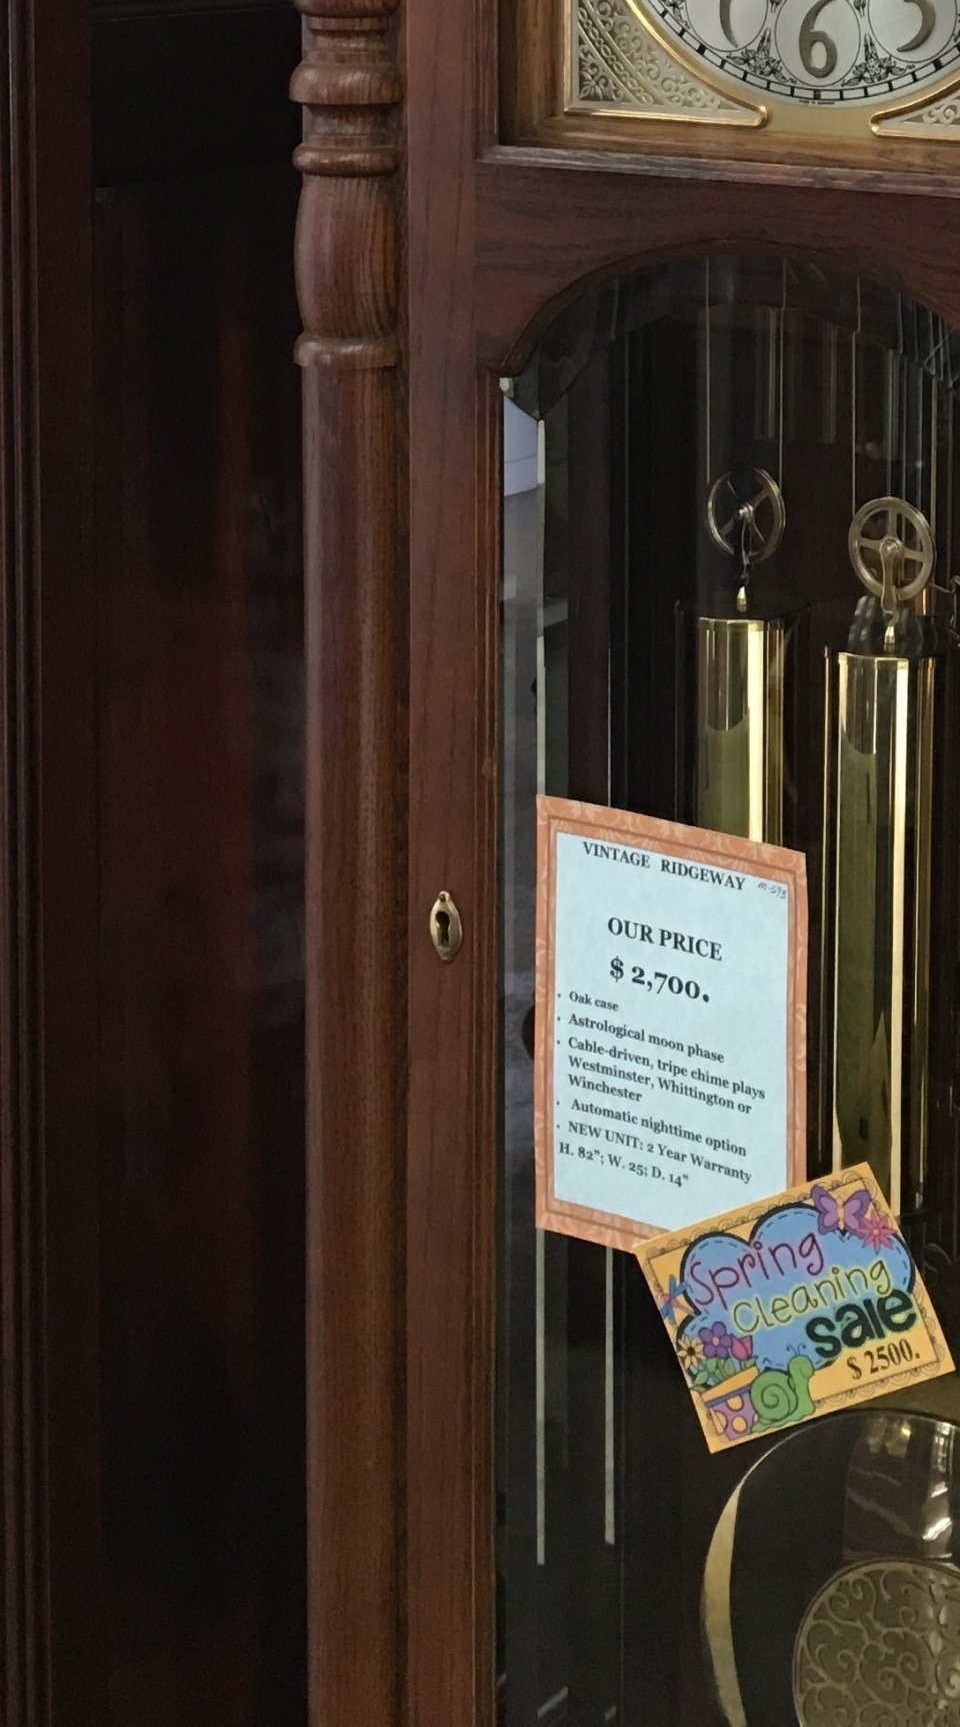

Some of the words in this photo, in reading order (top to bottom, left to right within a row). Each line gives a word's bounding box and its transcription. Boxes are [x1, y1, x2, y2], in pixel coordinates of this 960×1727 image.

[583, 841, 651, 868] VINTAGE
[661, 859, 746, 890] RIDGEWAY
[608, 917, 654, 944] OUR
[659, 929, 722, 961] PRICE
[569, 990, 592, 1005] Oak
[594, 998, 619, 1012] case
[610, 956, 624, 982] $
[632, 966, 710, 1003] 2,700.
[568, 1013, 645, 1042] Astrological
[648, 1033, 684, 1052] moon
[687, 1043, 724, 1063] phase
[568, 1036, 654, 1069] Cable-driven,
[657, 1058, 688, 1077] tripe
[691, 1067, 730, 1089] chime
[732, 1081, 766, 1099] plays
[568, 1055, 654, 1089] Westminster,
[657, 1076, 735, 1111] Whittington
[737, 1102, 752, 1115] or
[568, 1073, 643, 1102] Winchester
[571, 1098, 638, 1125] Automatic
[641, 1116, 702, 1143] nighttime
[705, 1135, 746, 1157] option
[559, 1142, 574, 1156] H.
[607, 1154, 625, 1169] W.
[628, 1162, 648, 1177] 25;
[651, 1166, 665, 1181] D.
[568, 1121, 602, 1139] NEW
[605, 1129, 644, 1150] UNIT:
[646, 1143, 654, 1153] 2
[657, 1144, 688, 1163] Year
[690, 1153, 752, 1184] Warranty
[690, 1232, 825, 1311] Spring
[846, 1356, 862, 1381] $
[863, 1339, 920, 1373] 2500.
